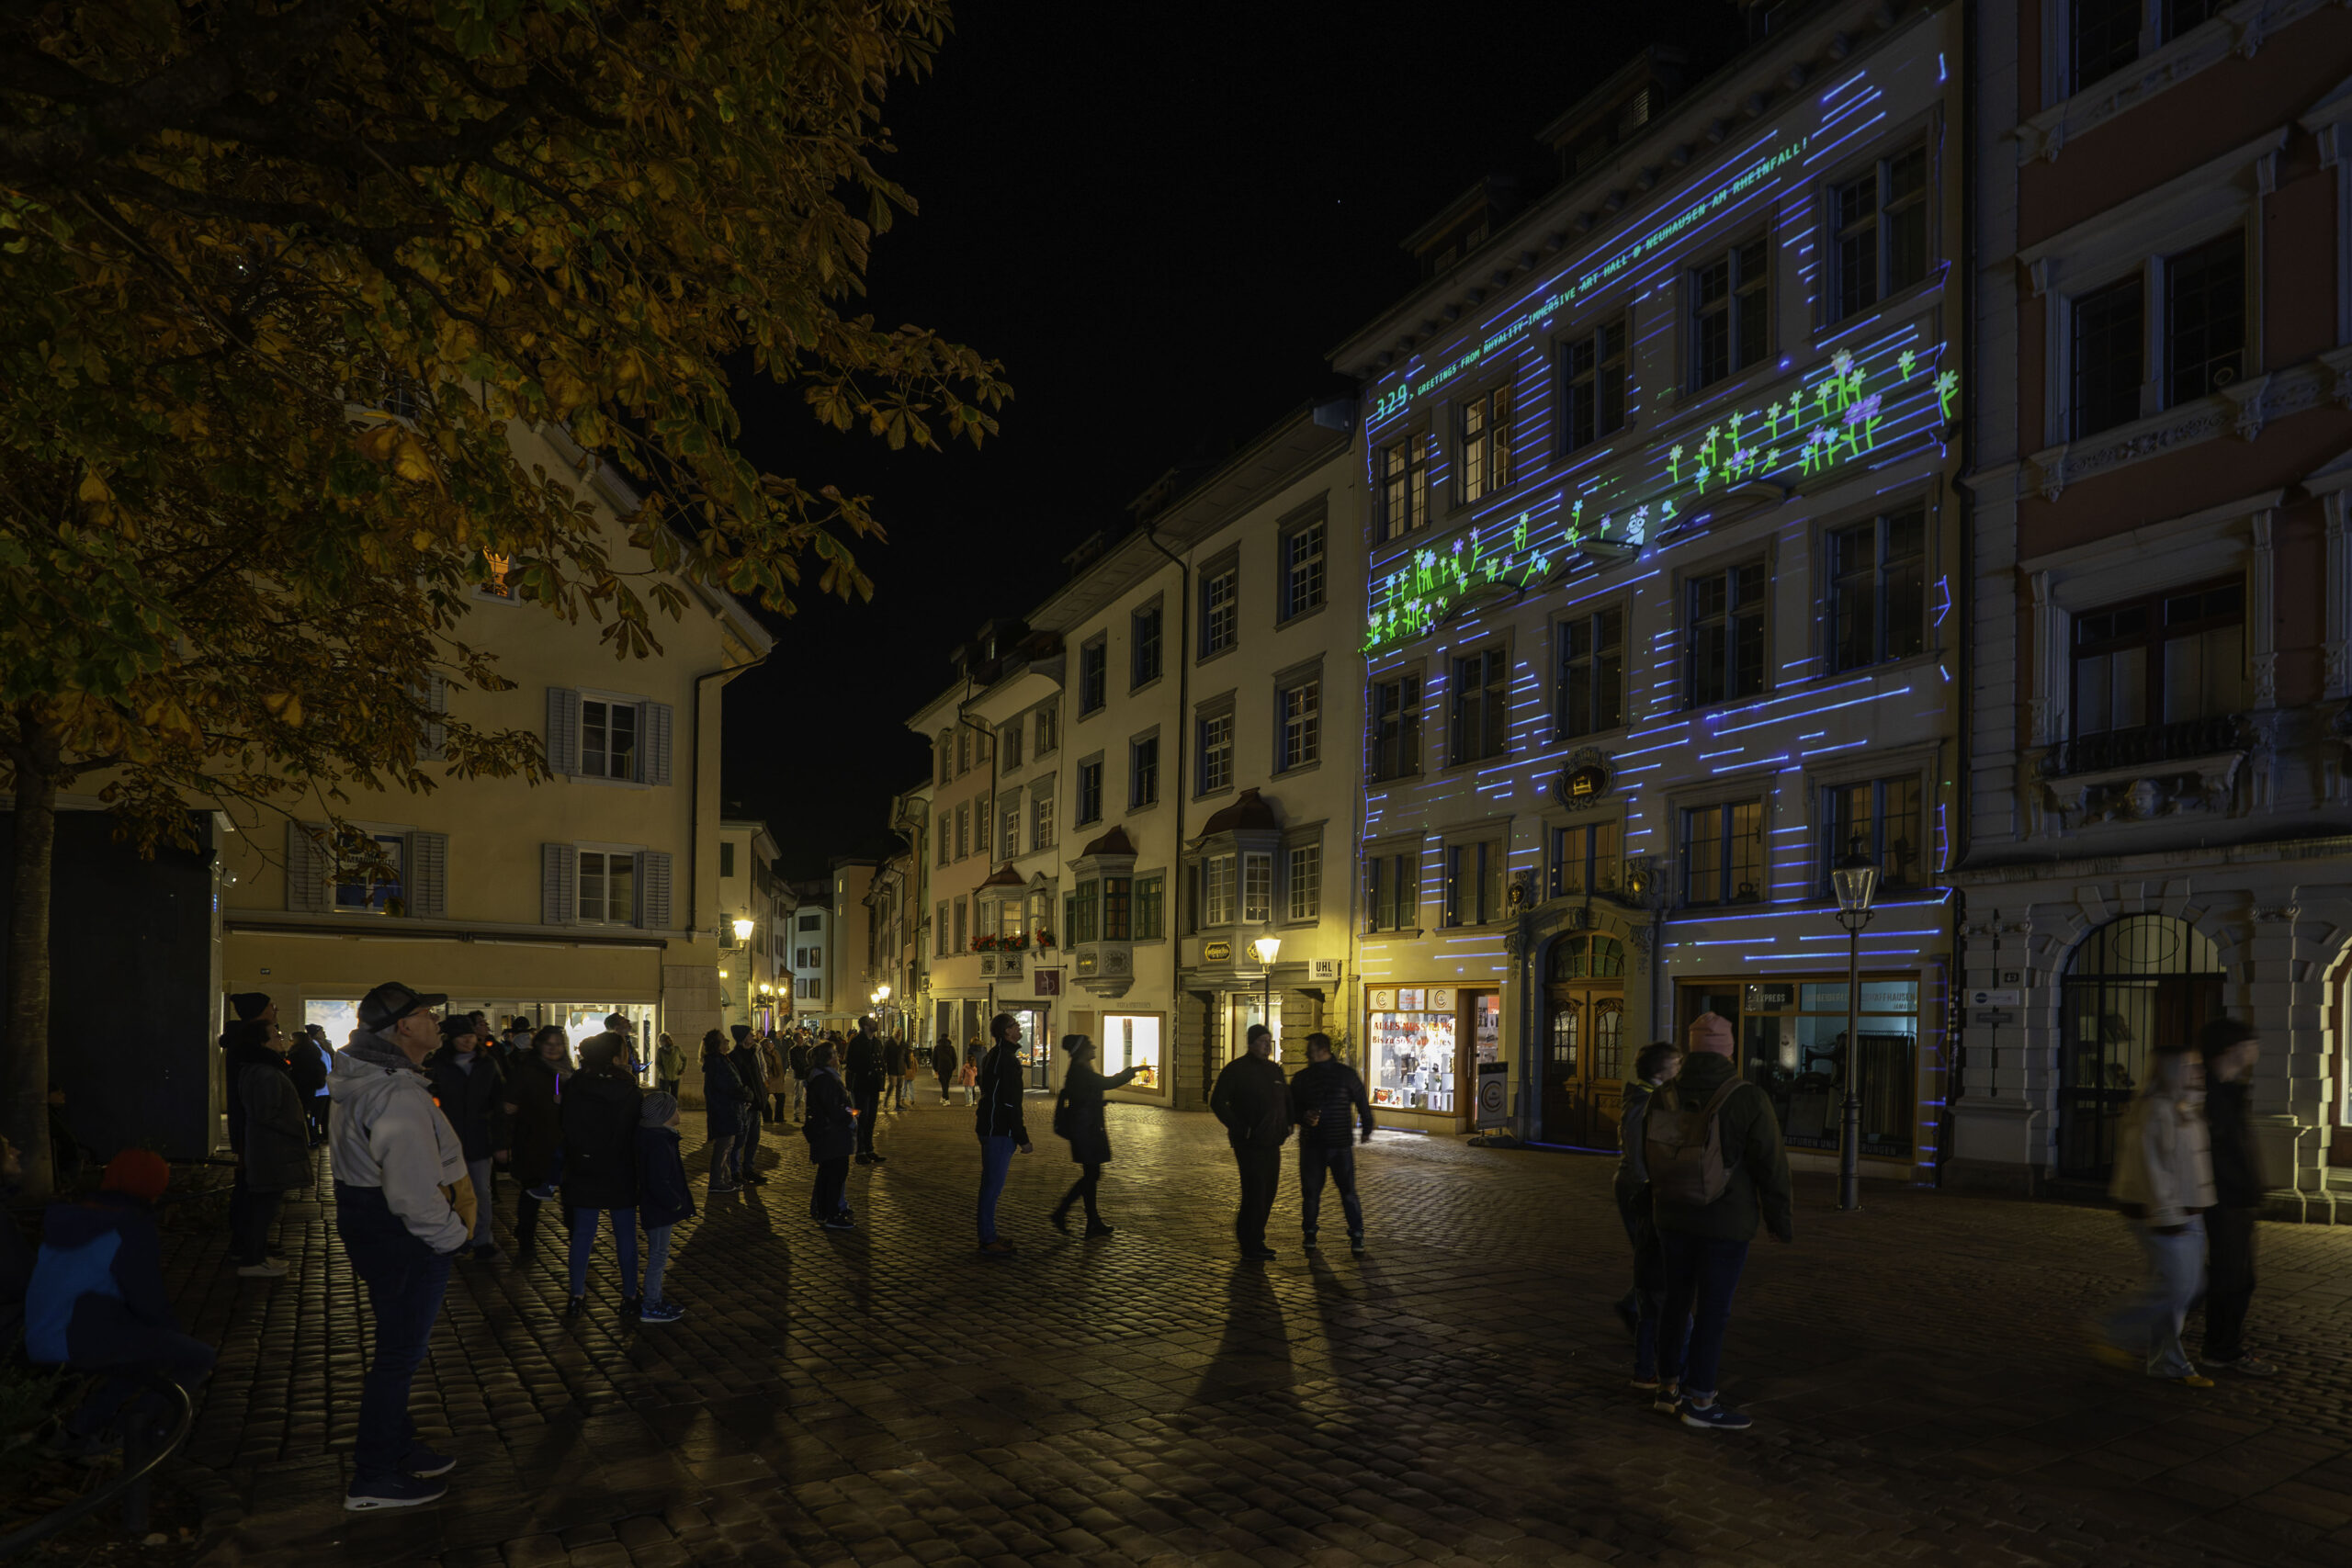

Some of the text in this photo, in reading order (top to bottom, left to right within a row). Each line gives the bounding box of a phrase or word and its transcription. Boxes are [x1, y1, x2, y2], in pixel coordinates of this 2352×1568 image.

[1376, 384, 1408, 422] 329
[1418, 364, 1457, 396] GREETINGS
[1461, 348, 1481, 369] FROM
[1483, 321, 1524, 355] RHYALITY
[1528, 287, 1577, 326] IMMERSIVE
[1580, 272, 1600, 292] ART
[1603, 254, 1628, 277] HALL
[1645, 203, 1706, 250] NEUHAUSEN
[1712, 189, 1727, 209] AM
[1733, 142, 1801, 195] RHEINFALL
[1316, 961, 1332, 972] UHL
[1756, 993, 1786, 1003] EXPRESS
[1374, 1021, 1400, 1030] ALLES
[1402, 1021, 1427, 1031] MUSS
[1820, 1137, 1838, 1149] UND
